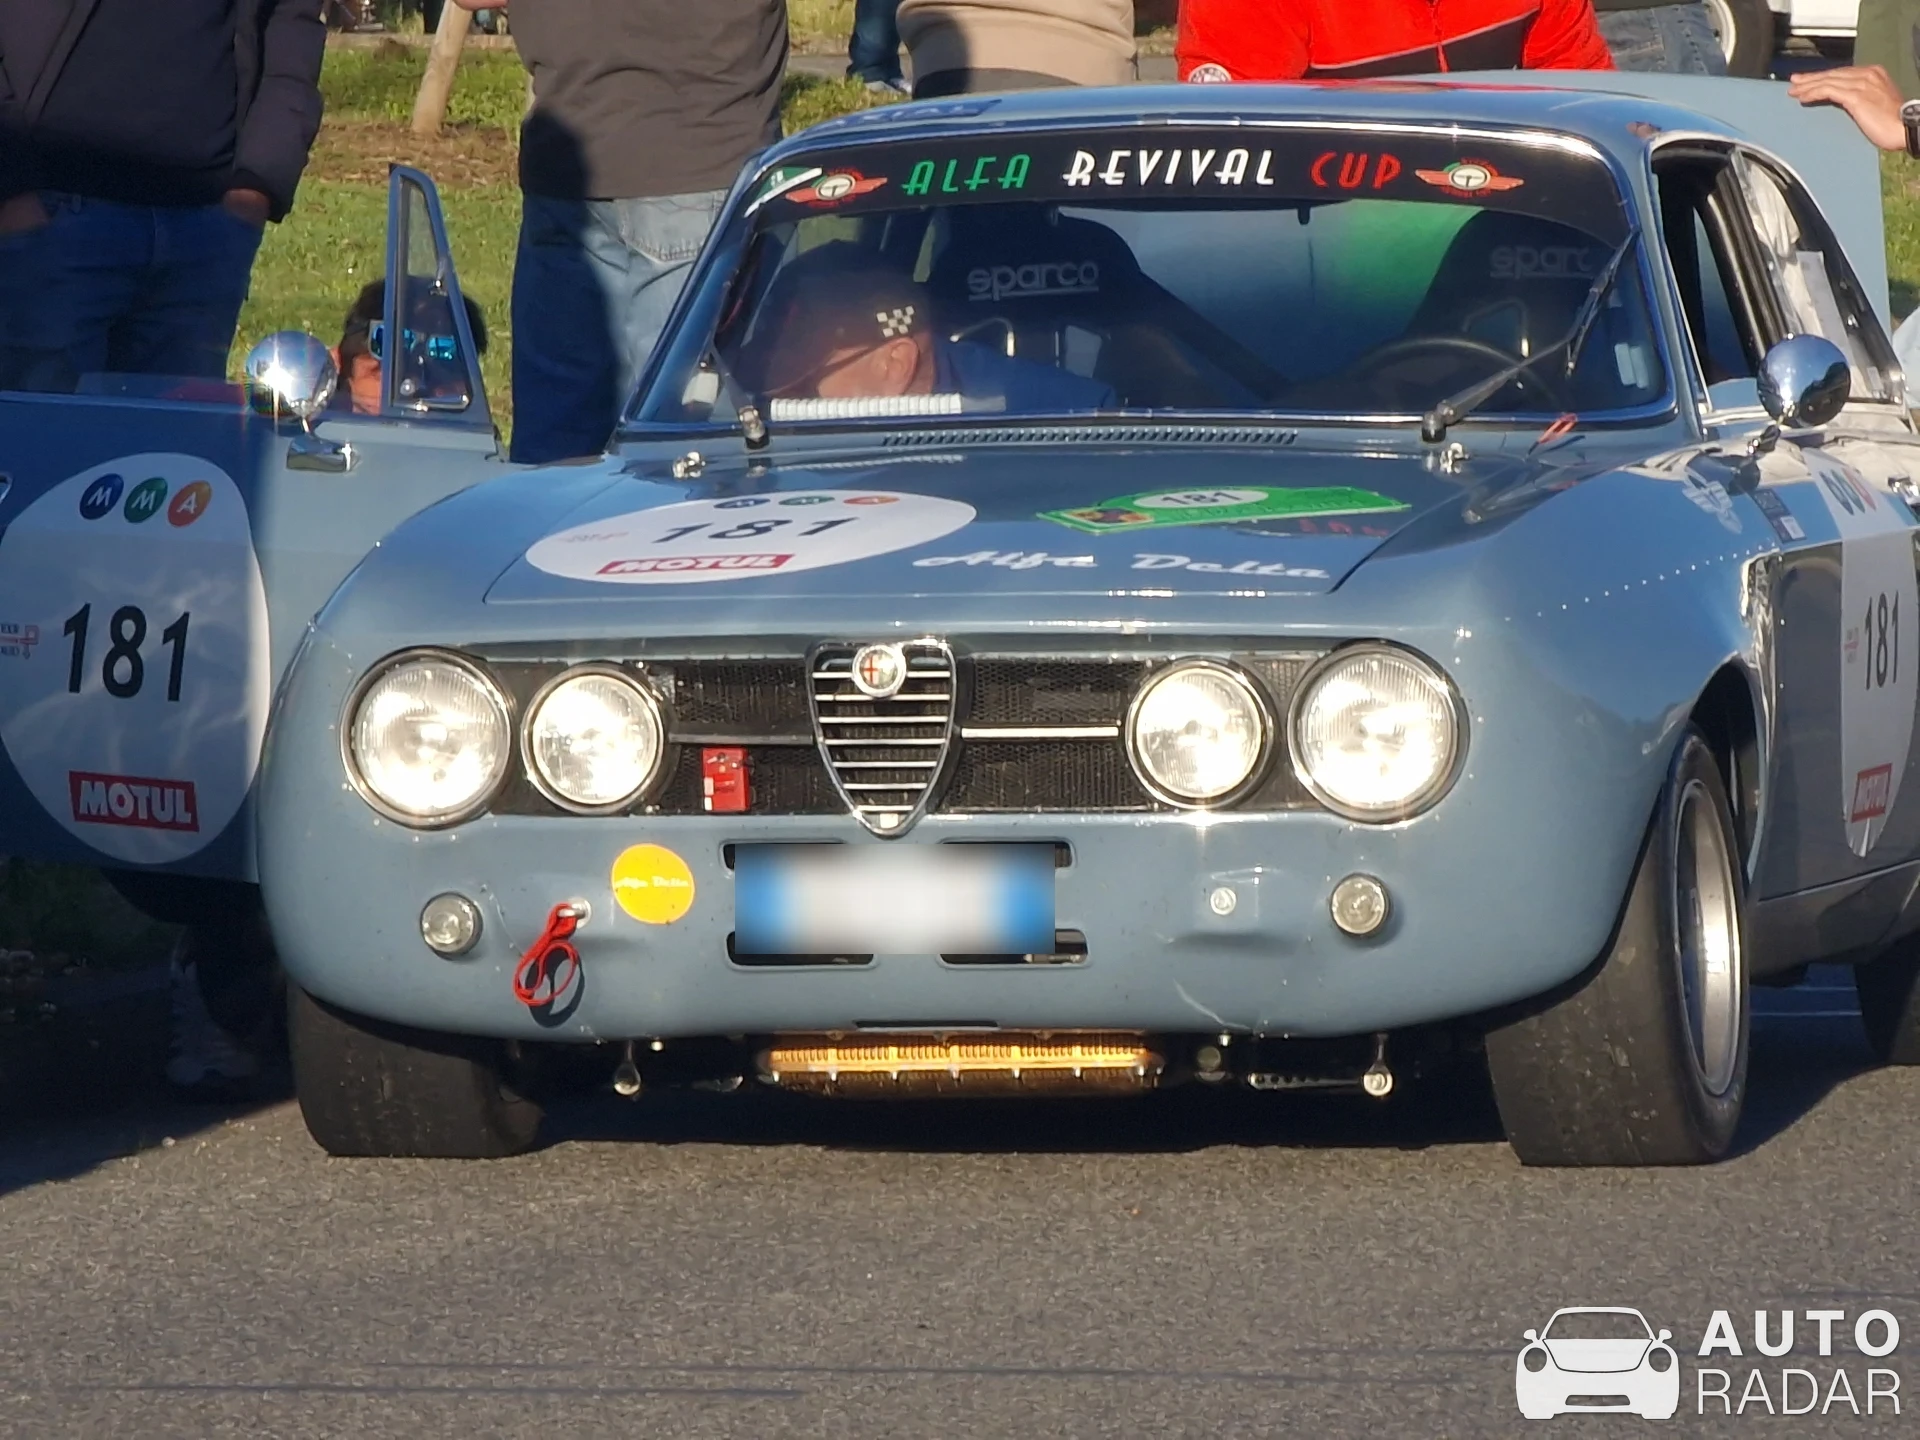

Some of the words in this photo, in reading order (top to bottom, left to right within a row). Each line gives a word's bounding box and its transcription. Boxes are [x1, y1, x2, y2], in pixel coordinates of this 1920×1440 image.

[902, 153, 1032, 196] ALFA
[1062, 148, 1276, 187] REVIVAL
[1310, 152, 1402, 189] CUP
[967, 260, 1100, 299] sparco
[650, 516, 861, 544] 181
[606, 555, 781, 574] MOTUL
[912, 550, 1099, 571] Alfa
[1131, 552, 1331, 579] Delta
[62, 602, 191, 702] 181
[1863, 589, 1900, 691] 181
[77, 779, 193, 825] MOTUL
